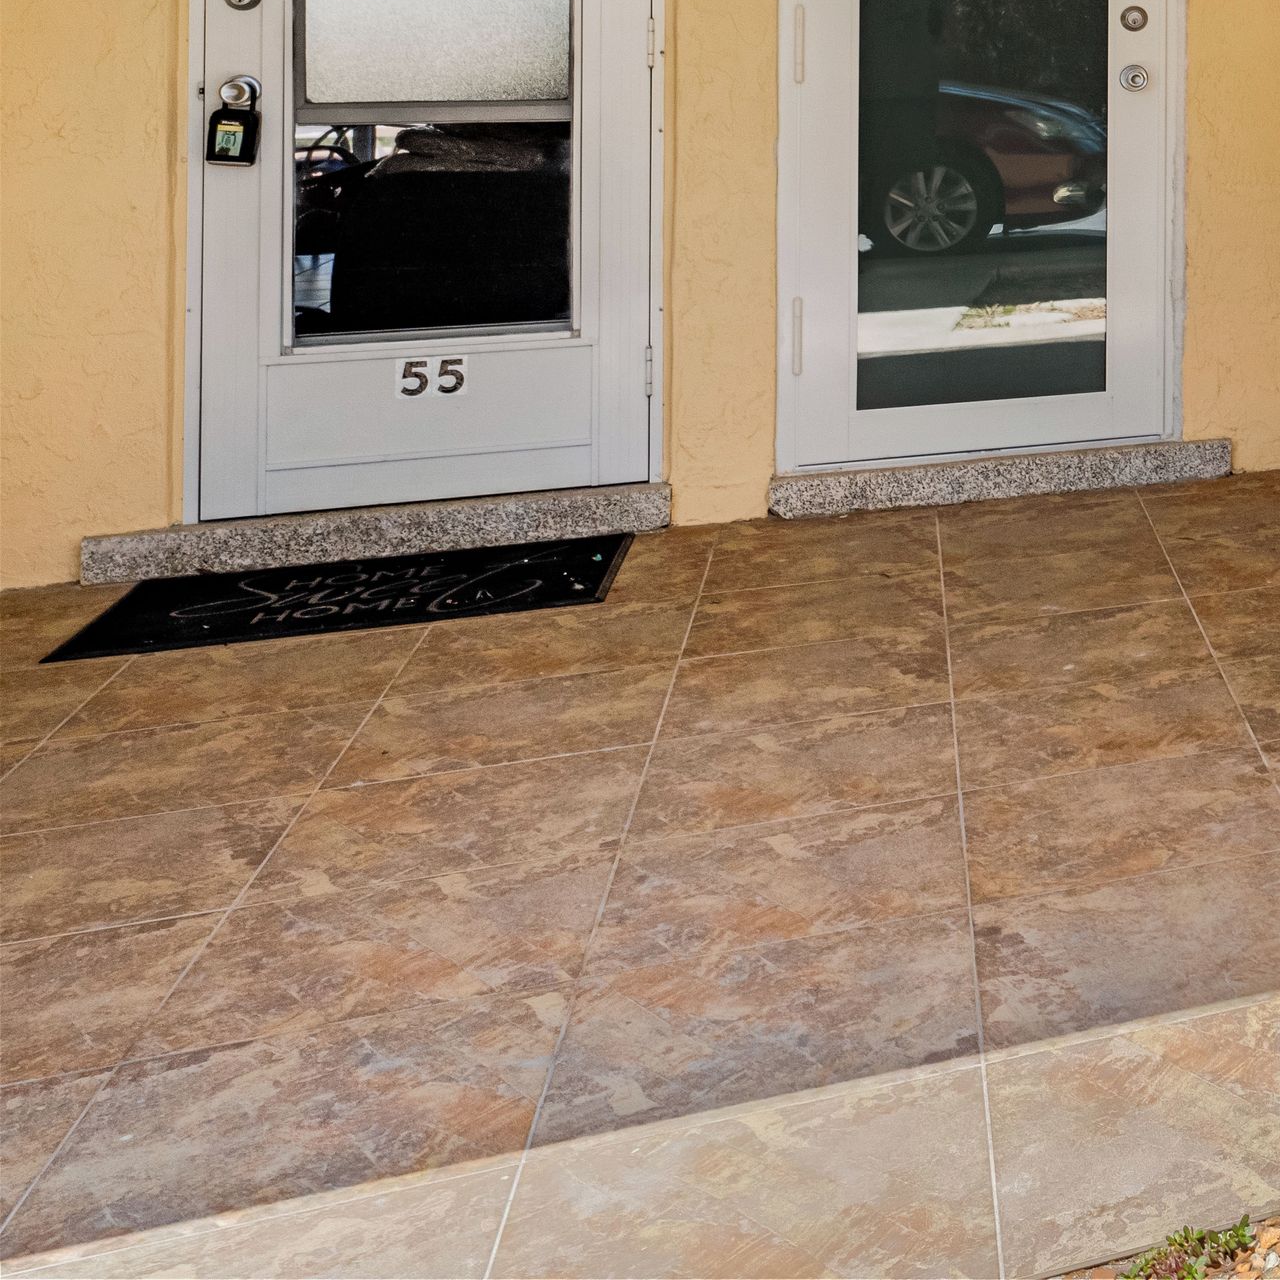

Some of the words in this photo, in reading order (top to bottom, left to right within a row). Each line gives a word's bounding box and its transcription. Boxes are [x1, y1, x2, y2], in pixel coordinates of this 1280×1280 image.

[400, 358, 465, 397] 55
[284, 565, 445, 591] HOME
[250, 596, 420, 624] HOME
